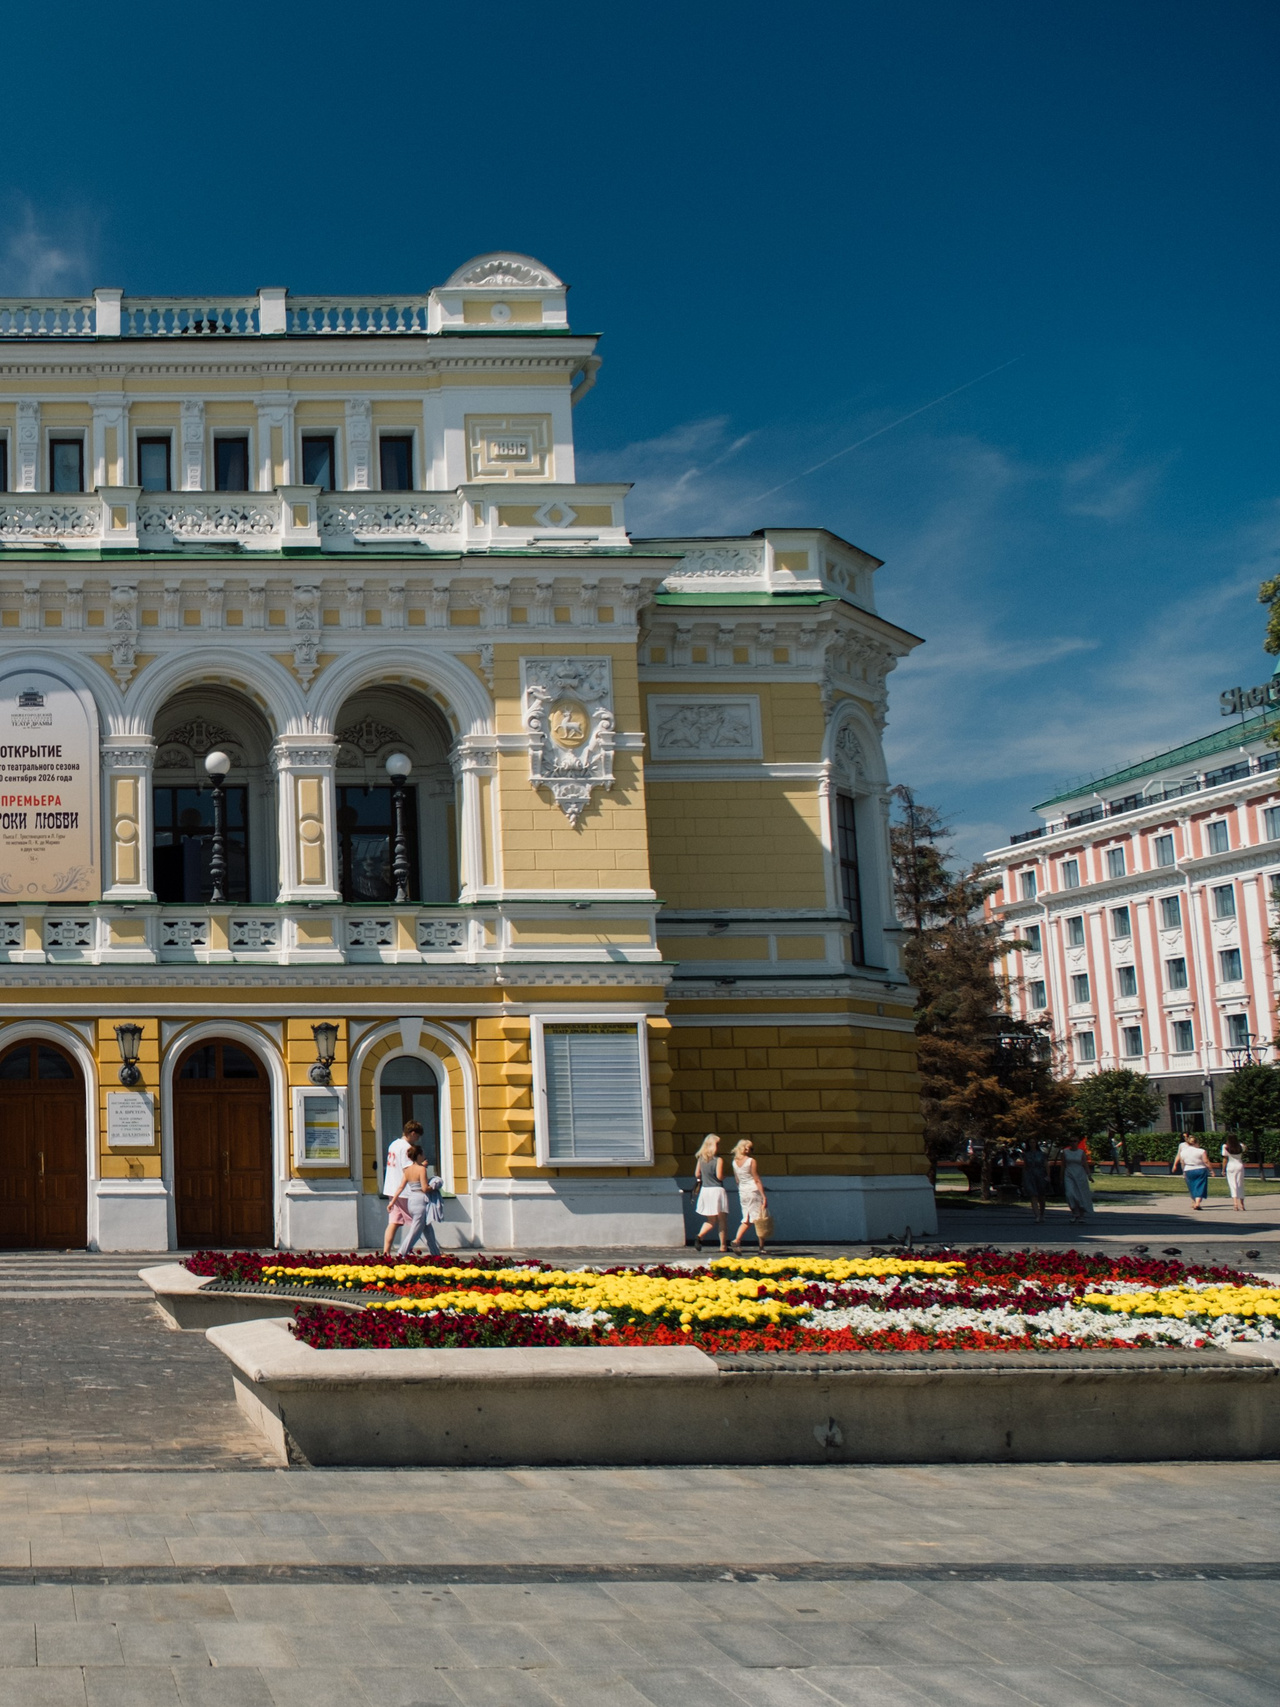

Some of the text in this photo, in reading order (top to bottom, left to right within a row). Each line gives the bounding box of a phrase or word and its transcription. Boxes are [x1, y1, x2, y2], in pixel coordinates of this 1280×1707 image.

[494, 441, 526, 456] 1896
[0, 745, 62, 758] ОТКРЫТИЕ
[7, 763, 54, 772] театрального
[4, 774, 36, 783] сентября
[1, 795, 62, 806] ПРЕМЬЕРА
[35, 812, 78, 829] ЛЮБВИ
